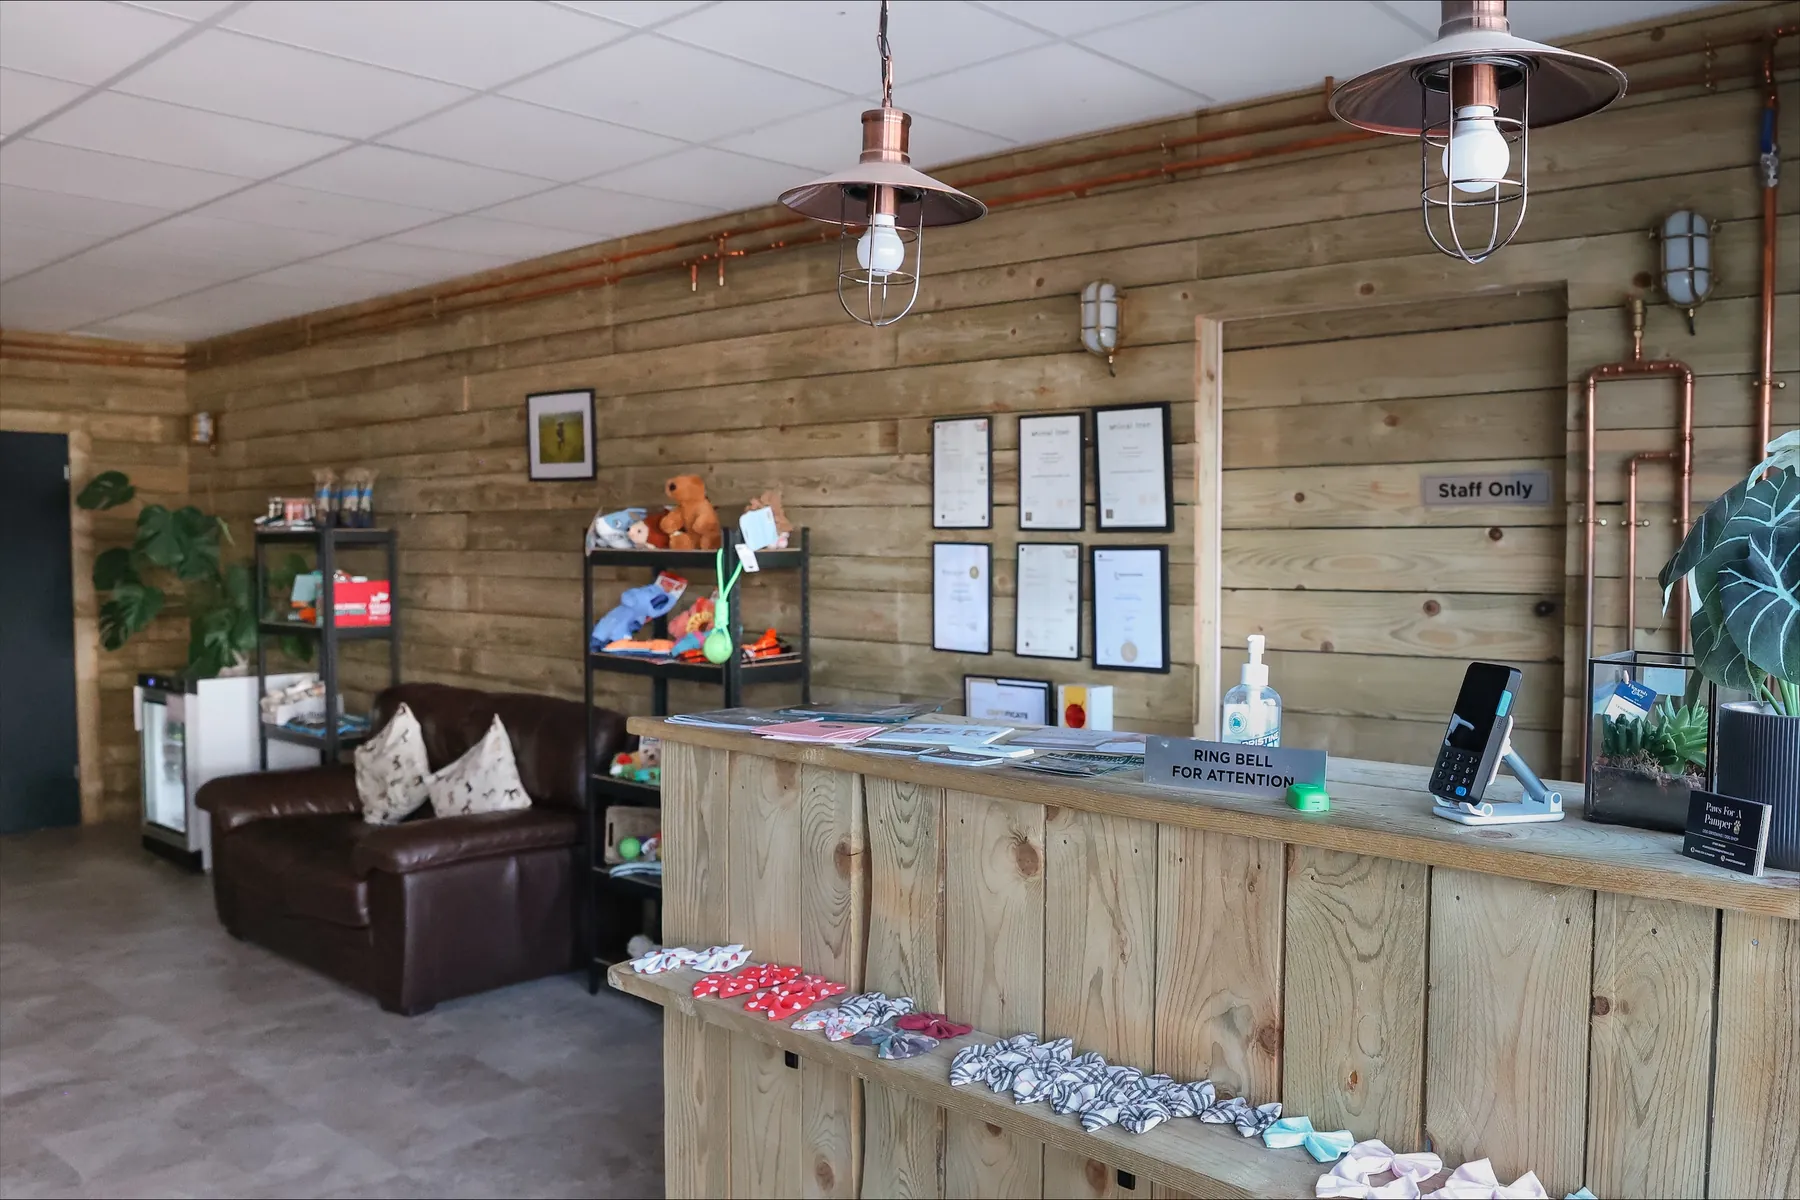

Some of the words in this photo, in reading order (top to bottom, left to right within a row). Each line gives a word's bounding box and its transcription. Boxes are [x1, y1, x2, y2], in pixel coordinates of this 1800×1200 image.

[1439, 481, 1482, 498] Staff
[1489, 480, 1533, 499] Only
[1194, 749, 1231, 764] RING
[1235, 753, 1273, 768] BELL
[1172, 765, 1203, 780] FOR
[1206, 769, 1295, 788] ATTENTION
[1706, 802, 1722, 814] Paws
[1723, 806, 1735, 816] For
[1736, 810, 1742, 819] A
[1704, 814, 1732, 830] Pamper
